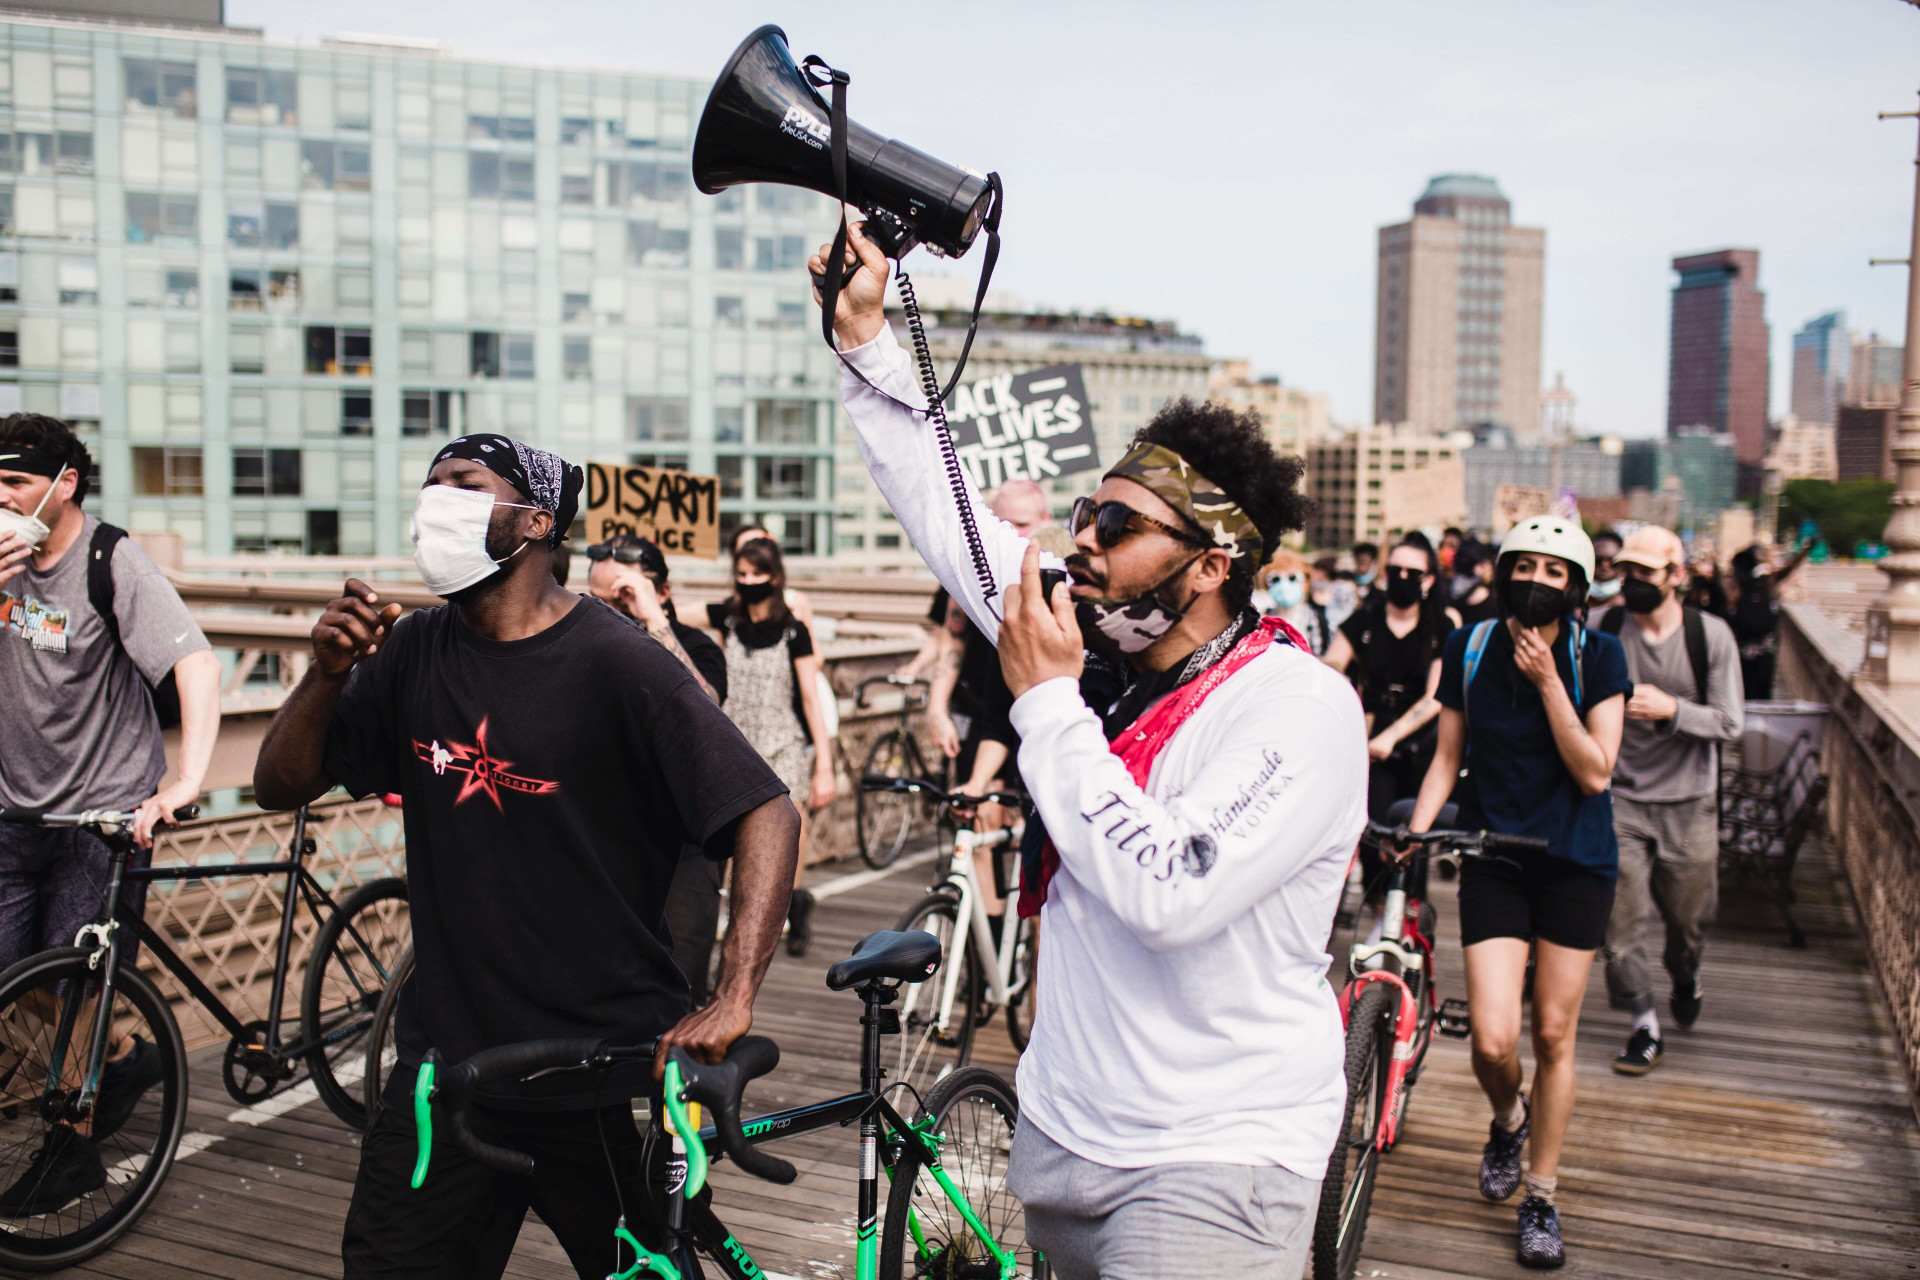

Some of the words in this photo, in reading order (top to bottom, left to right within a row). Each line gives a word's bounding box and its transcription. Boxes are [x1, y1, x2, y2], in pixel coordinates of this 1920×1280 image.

[779, 120, 823, 150] PyleUSA.com
[942, 372, 1021, 422] LACK
[976, 394, 1082, 448] LIVES
[957, 439, 1062, 489] TTER
[587, 463, 715, 525] DISARM
[1208, 748, 1284, 839] Handmade
[1232, 775, 1294, 839] VODKA
[742, 1120, 774, 1137] ENT
